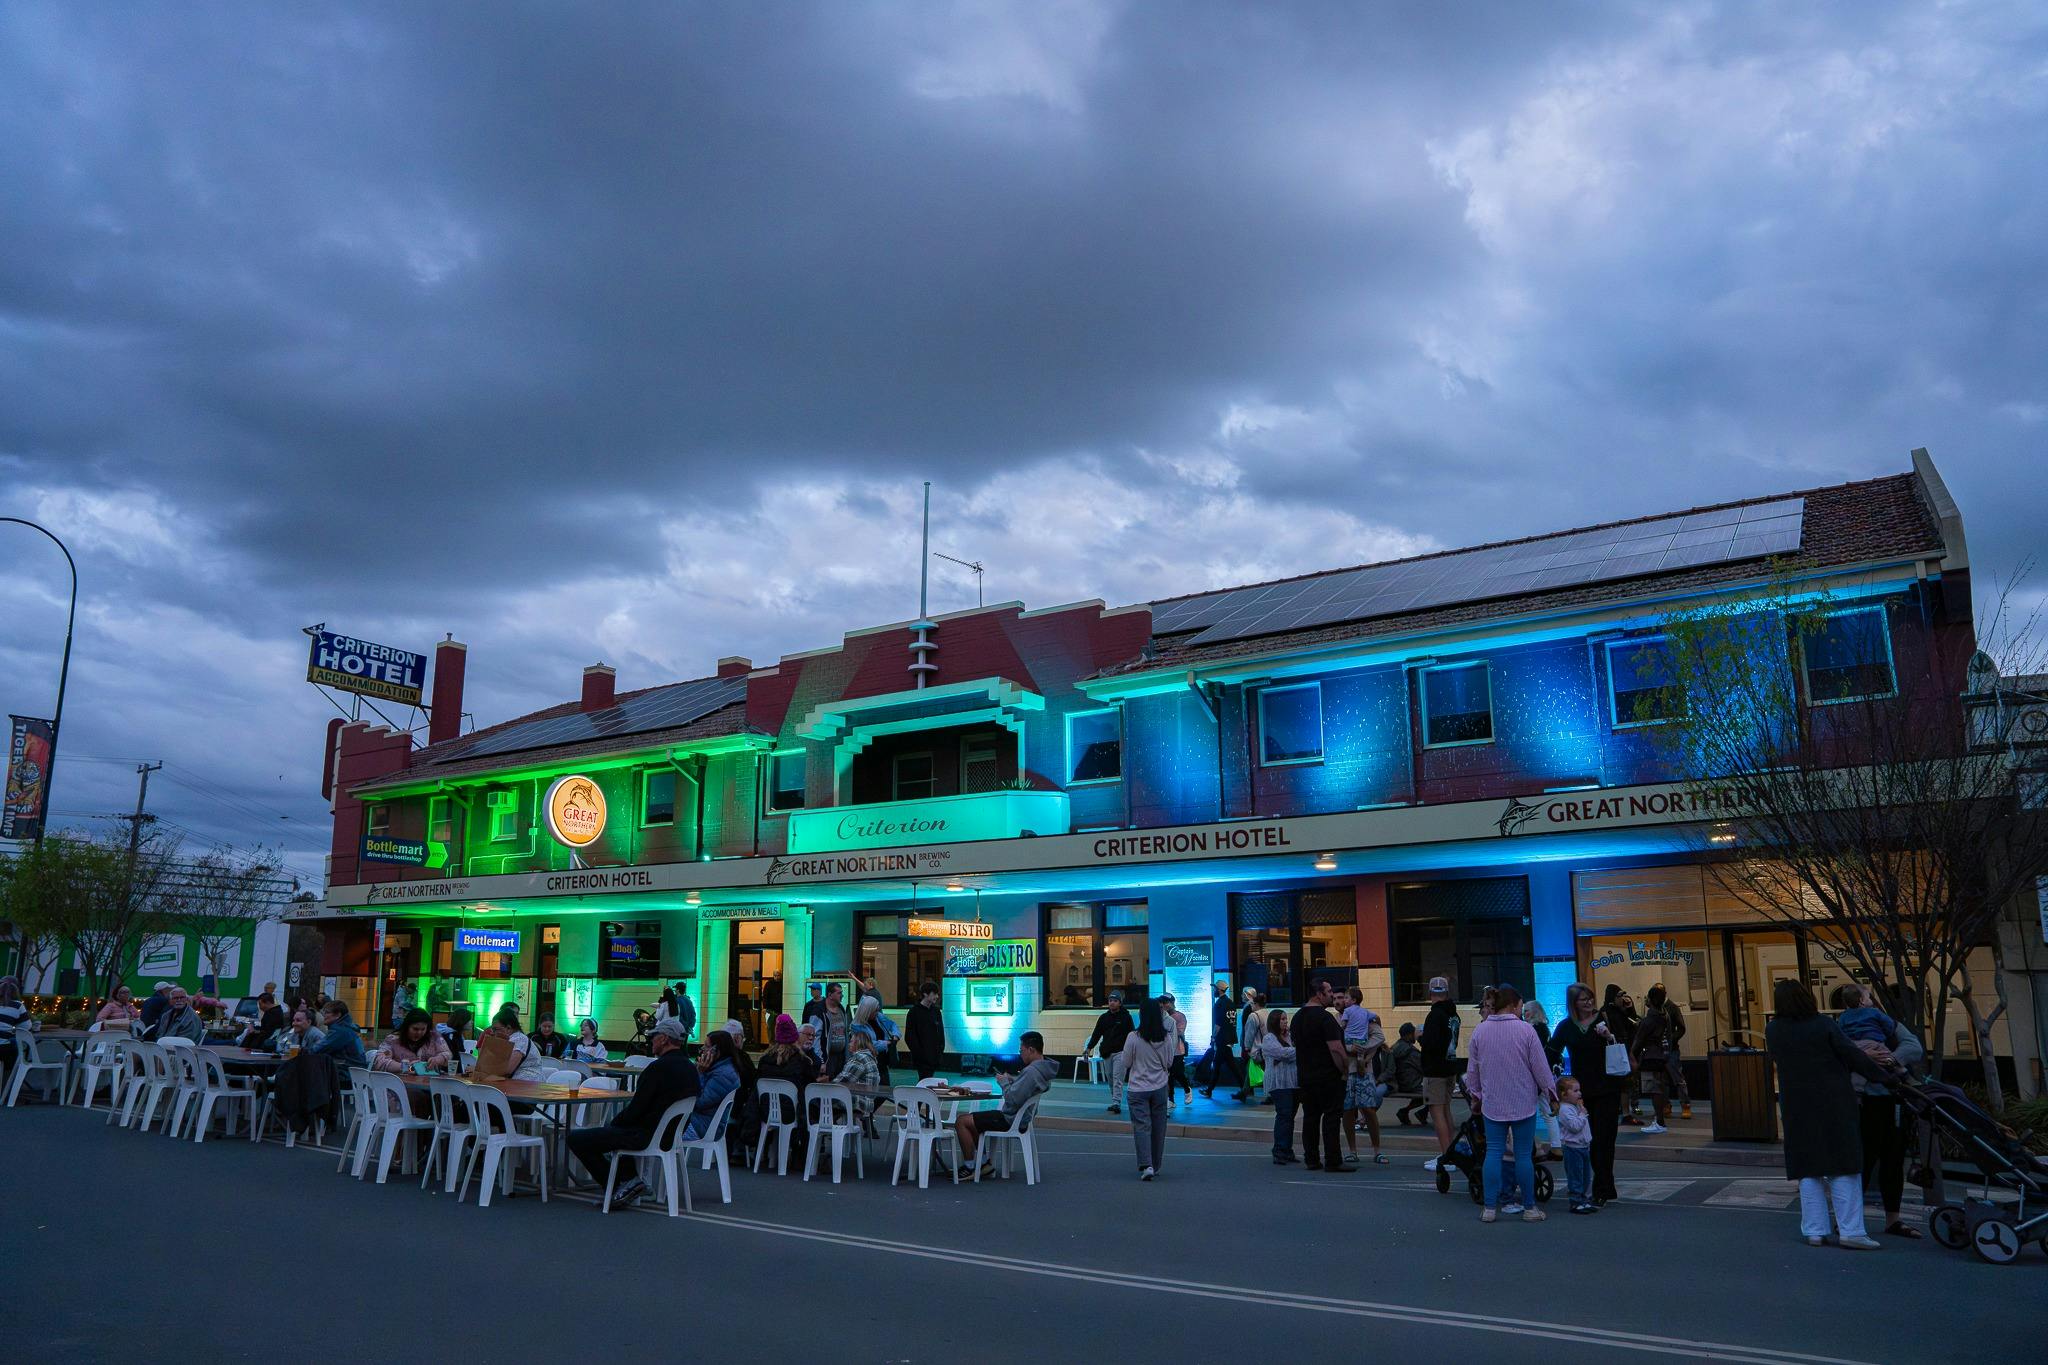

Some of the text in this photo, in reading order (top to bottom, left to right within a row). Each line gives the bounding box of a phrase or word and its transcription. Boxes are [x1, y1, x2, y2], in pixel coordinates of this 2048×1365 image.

[318, 648, 419, 688] HOTEL
[316, 671, 417, 701] ACCOMMODATION
[12, 724, 27, 766] TIGER
[563, 808, 598, 823] GREAT
[1547, 797, 1624, 822] GREAT
[3, 804, 17, 837] TIME
[837, 813, 950, 840] Criterion
[366, 839, 423, 856] Bottlemart
[1094, 827, 1290, 857] CRITERION HOTEL
[381, 852, 394, 860] thru
[394, 854, 422, 863] bottleshop
[792, 853, 917, 876] GREAT NORTHERN
[919, 851, 950, 860] BREWING
[547, 871, 652, 891] CRITERION HOTEL
[382, 883, 452, 899] GREAT NORTHERN
[702, 908, 750, 918] ACCOMMODATION
[757, 906, 778, 916] MEALS
[950, 923, 991, 938] BISTRO
[463, 934, 514, 948] Bottlemart
[949, 945, 985, 956] Criterion
[987, 943, 1033, 969] BISTRO
[1590, 939, 1693, 969] coin laundry
[957, 957, 977, 968] Hotel
[290, 971, 299, 979] 50
